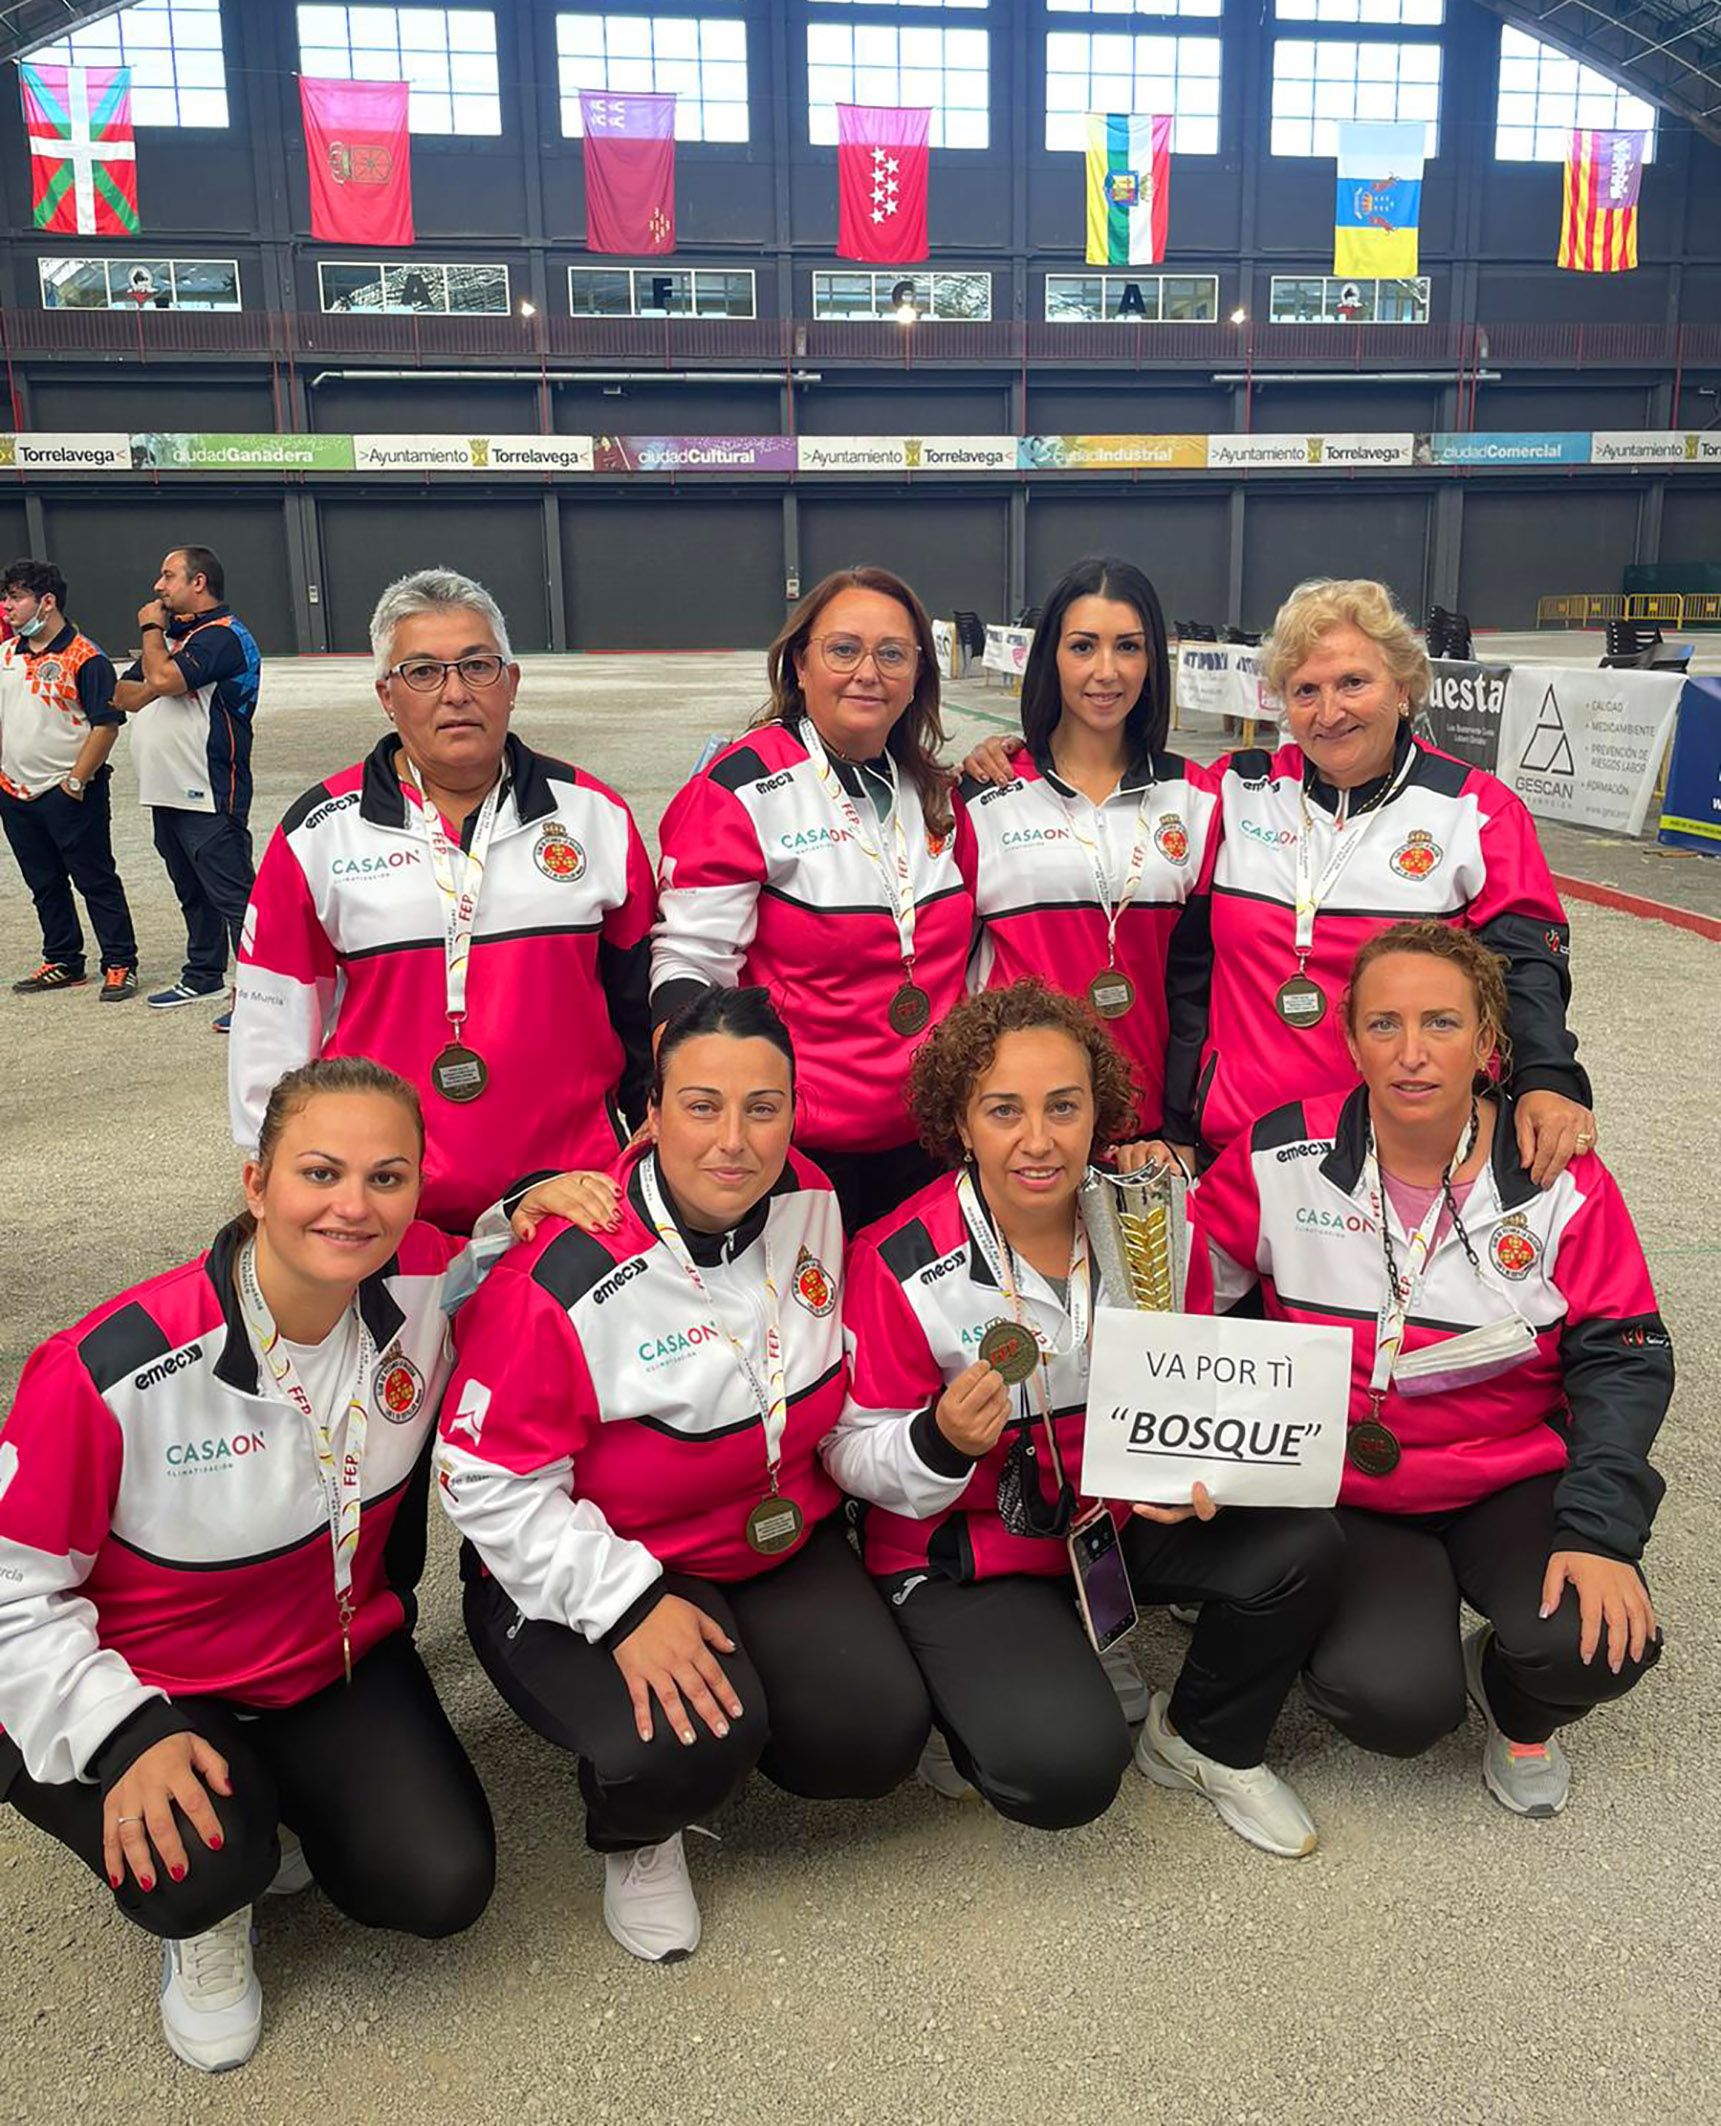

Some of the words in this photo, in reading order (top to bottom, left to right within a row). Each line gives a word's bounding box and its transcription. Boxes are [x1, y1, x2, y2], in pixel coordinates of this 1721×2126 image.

[19, 447, 114, 466] Torrelavega
[173, 446, 314, 463] ciudadGanadera
[369, 448, 468, 466] Ayuntamiento
[491, 448, 578, 466] Torrelavega
[639, 449, 755, 464] ciudadCultural
[810, 449, 903, 467] Ayuntamiento
[924, 449, 1004, 467] Torrelavega
[1219, 447, 1305, 464] Ayuntamiento
[1325, 447, 1400, 463] Torrelavega
[1443, 444, 1561, 460] ciudadComercial
[1602, 444, 1683, 460] Ayuntamiento
[1430, 673, 1504, 713] uesta
[1622, 763, 1646, 774] LABOR
[1515, 776, 1574, 799] GESCAN
[305, 798, 350, 829] emec
[1002, 828, 1069, 844] CASAON
[332, 849, 421, 875] CASAON
[458, 893, 474, 922] FEP
[1276, 1140, 1321, 1163] emec
[1296, 1207, 1376, 1234] CASAON
[593, 1262, 636, 1305] emec
[638, 1320, 719, 1361] CASAON
[768, 1327, 781, 1360] FEP
[134, 1350, 190, 1390] emec
[1147, 1351, 1186, 1380] VA
[1197, 1355, 1256, 1386] POR
[166, 1430, 266, 1465] CASAON
[344, 1454, 360, 1487] FEP
[0, 1566, 24, 1584] rcia
